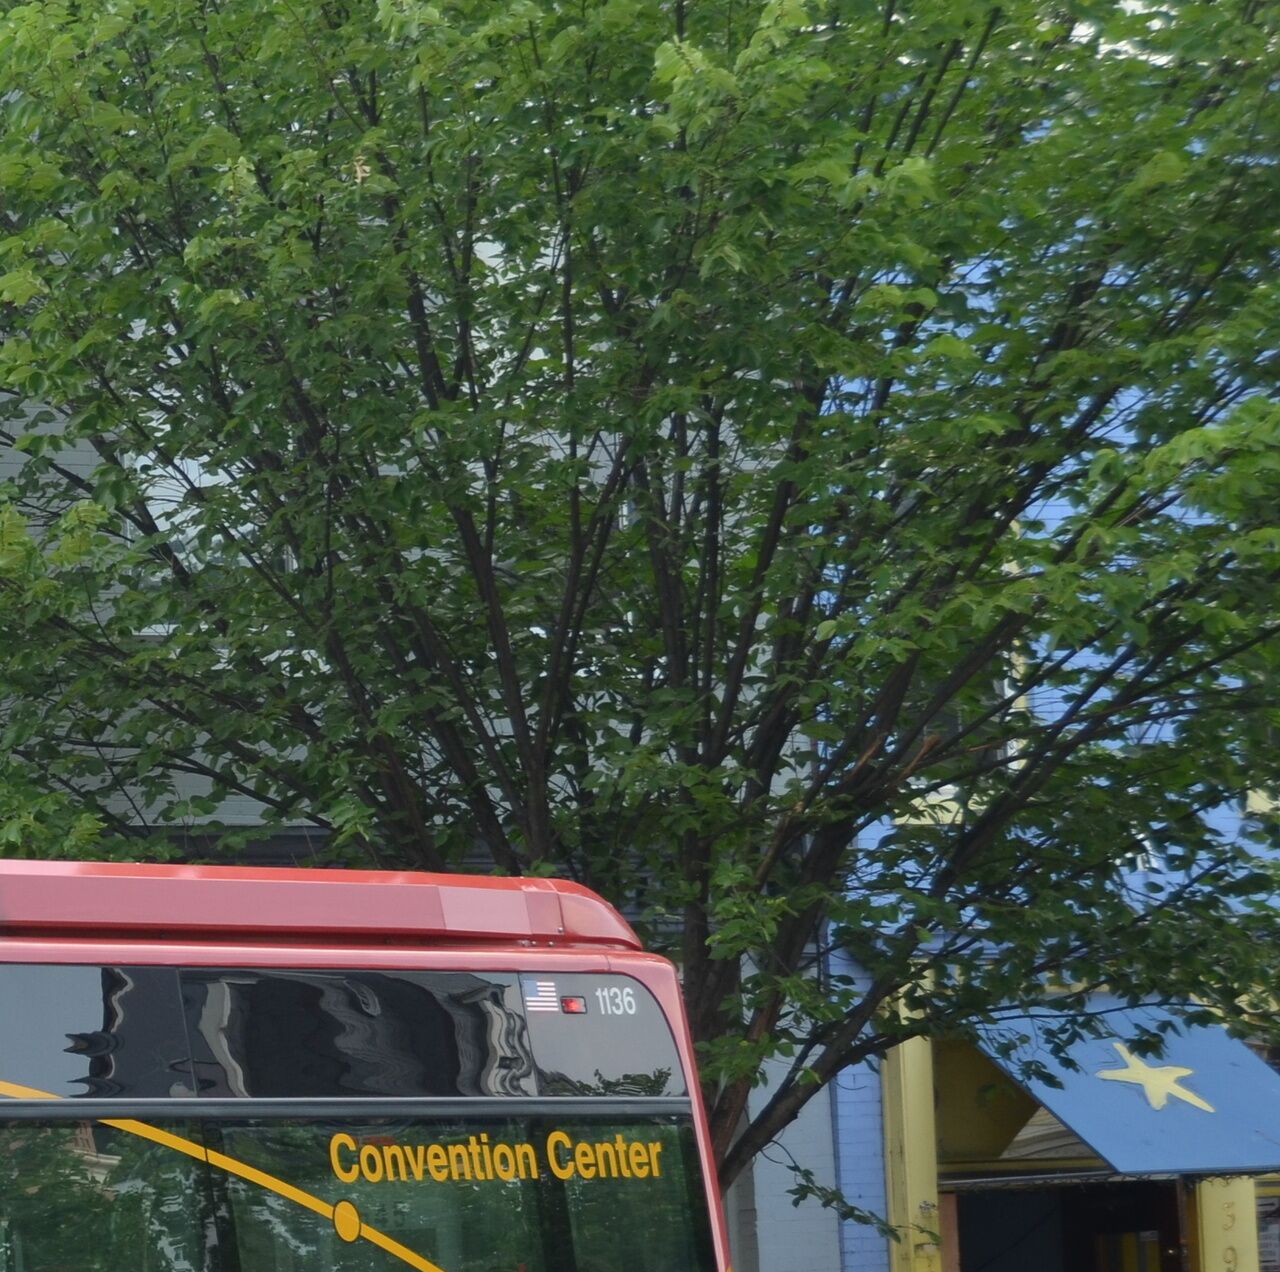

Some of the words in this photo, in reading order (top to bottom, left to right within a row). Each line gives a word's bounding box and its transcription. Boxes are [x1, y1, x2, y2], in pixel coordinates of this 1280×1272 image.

[595, 986, 636, 1016] 1136
[329, 1132, 539, 1183] Convention
[546, 1131, 662, 1180] Center
